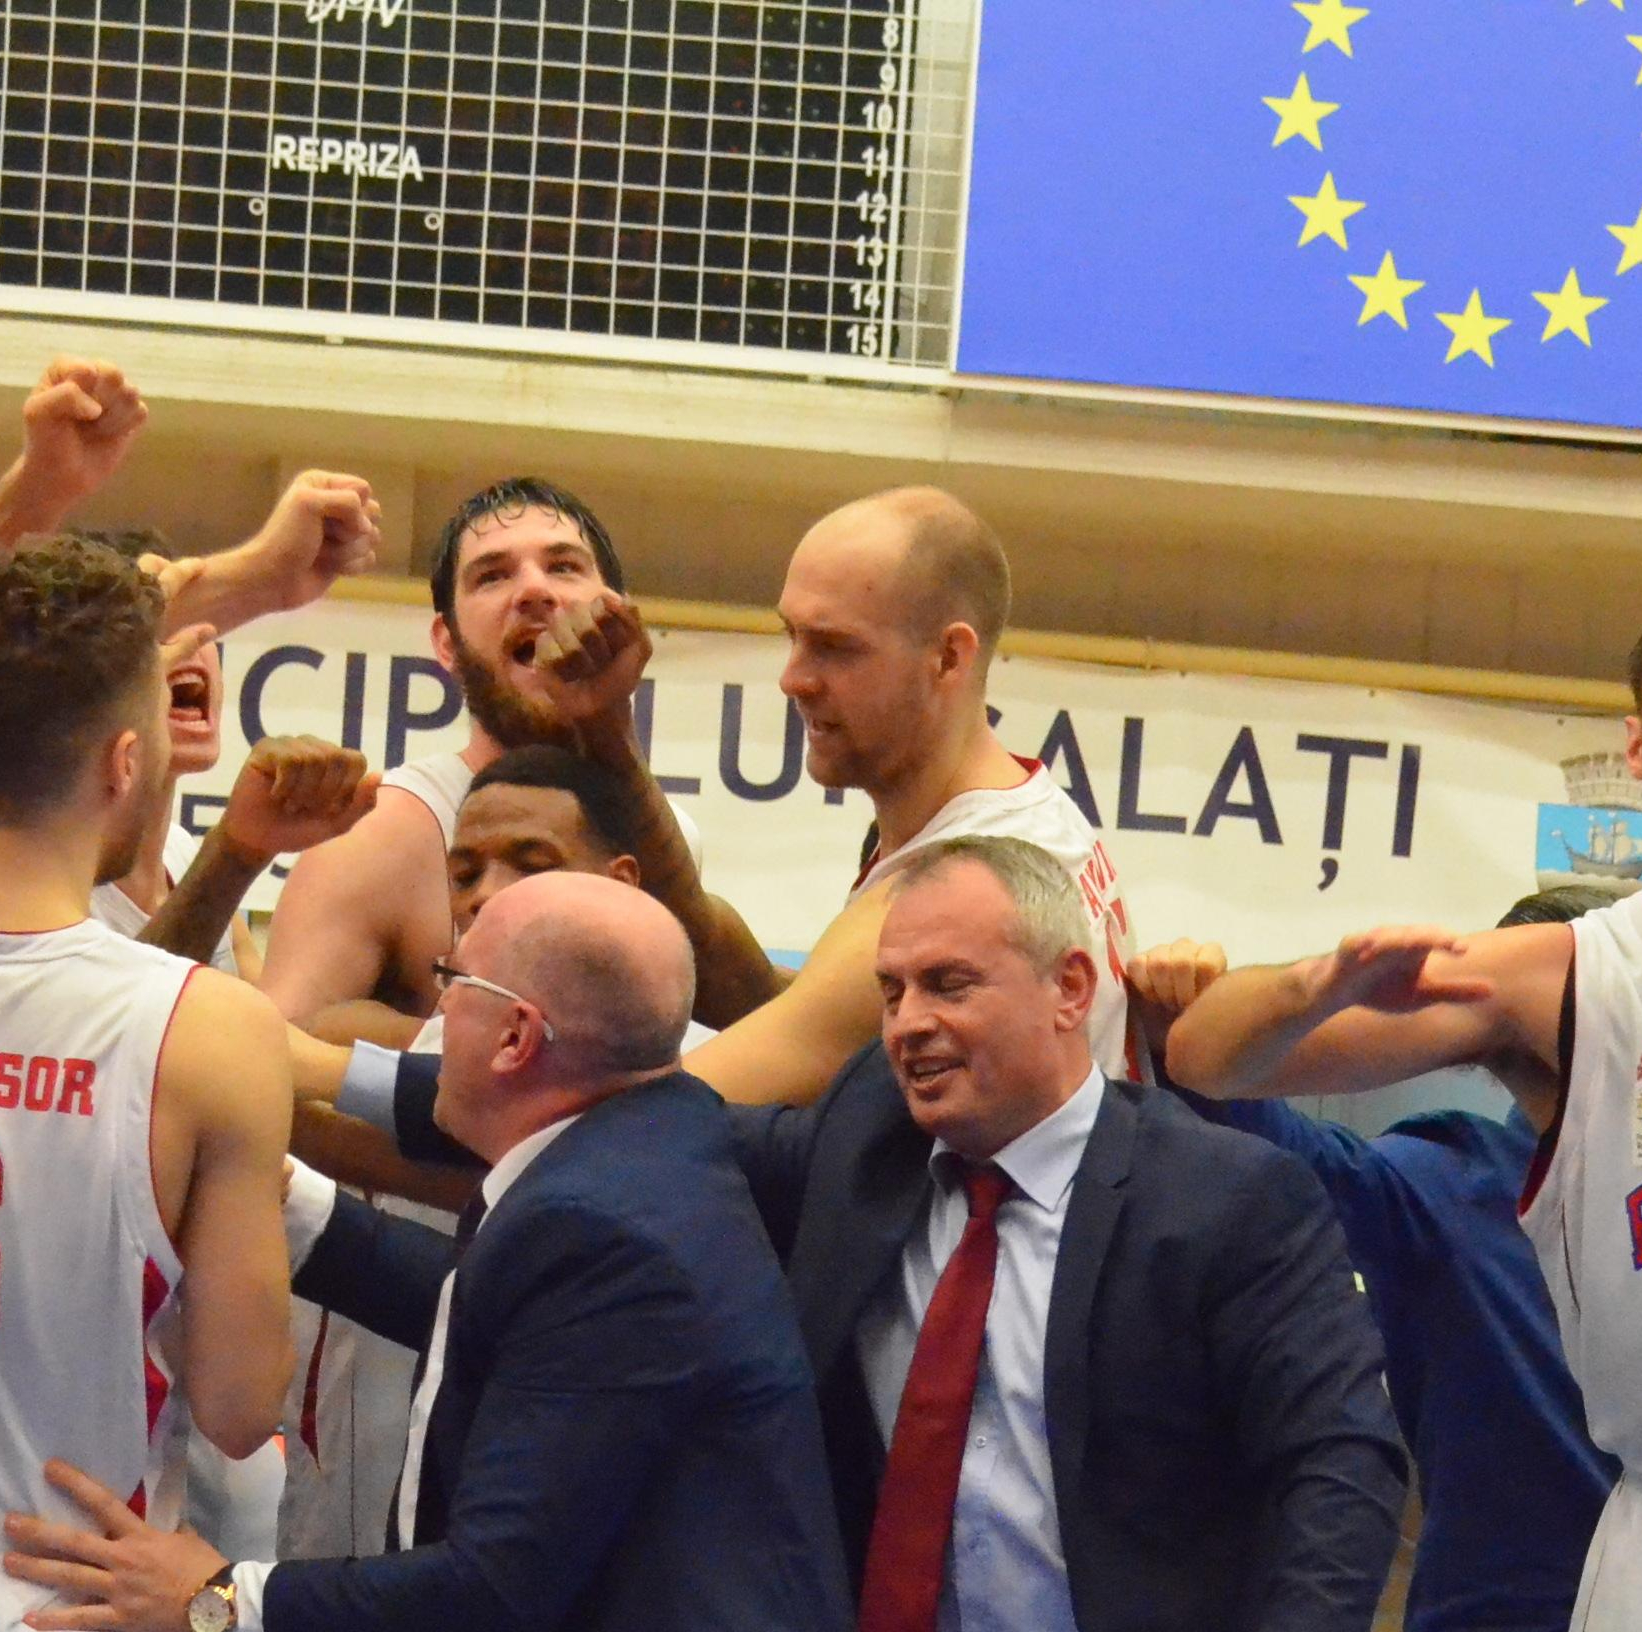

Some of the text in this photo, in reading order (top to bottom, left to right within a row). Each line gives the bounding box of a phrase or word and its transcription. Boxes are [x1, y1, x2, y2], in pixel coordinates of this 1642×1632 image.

[883, 18, 899, 49] 8
[880, 62, 896, 92] 9
[862, 101, 893, 132] 10
[272, 134, 424, 182] REPRIZA
[861, 147, 888, 178] 11
[857, 191, 887, 223] 12
[856, 235, 884, 267] 13
[849, 282, 880, 311] 14
[846, 325, 878, 356] 15
[984, 704, 1421, 891] ALAȚI
